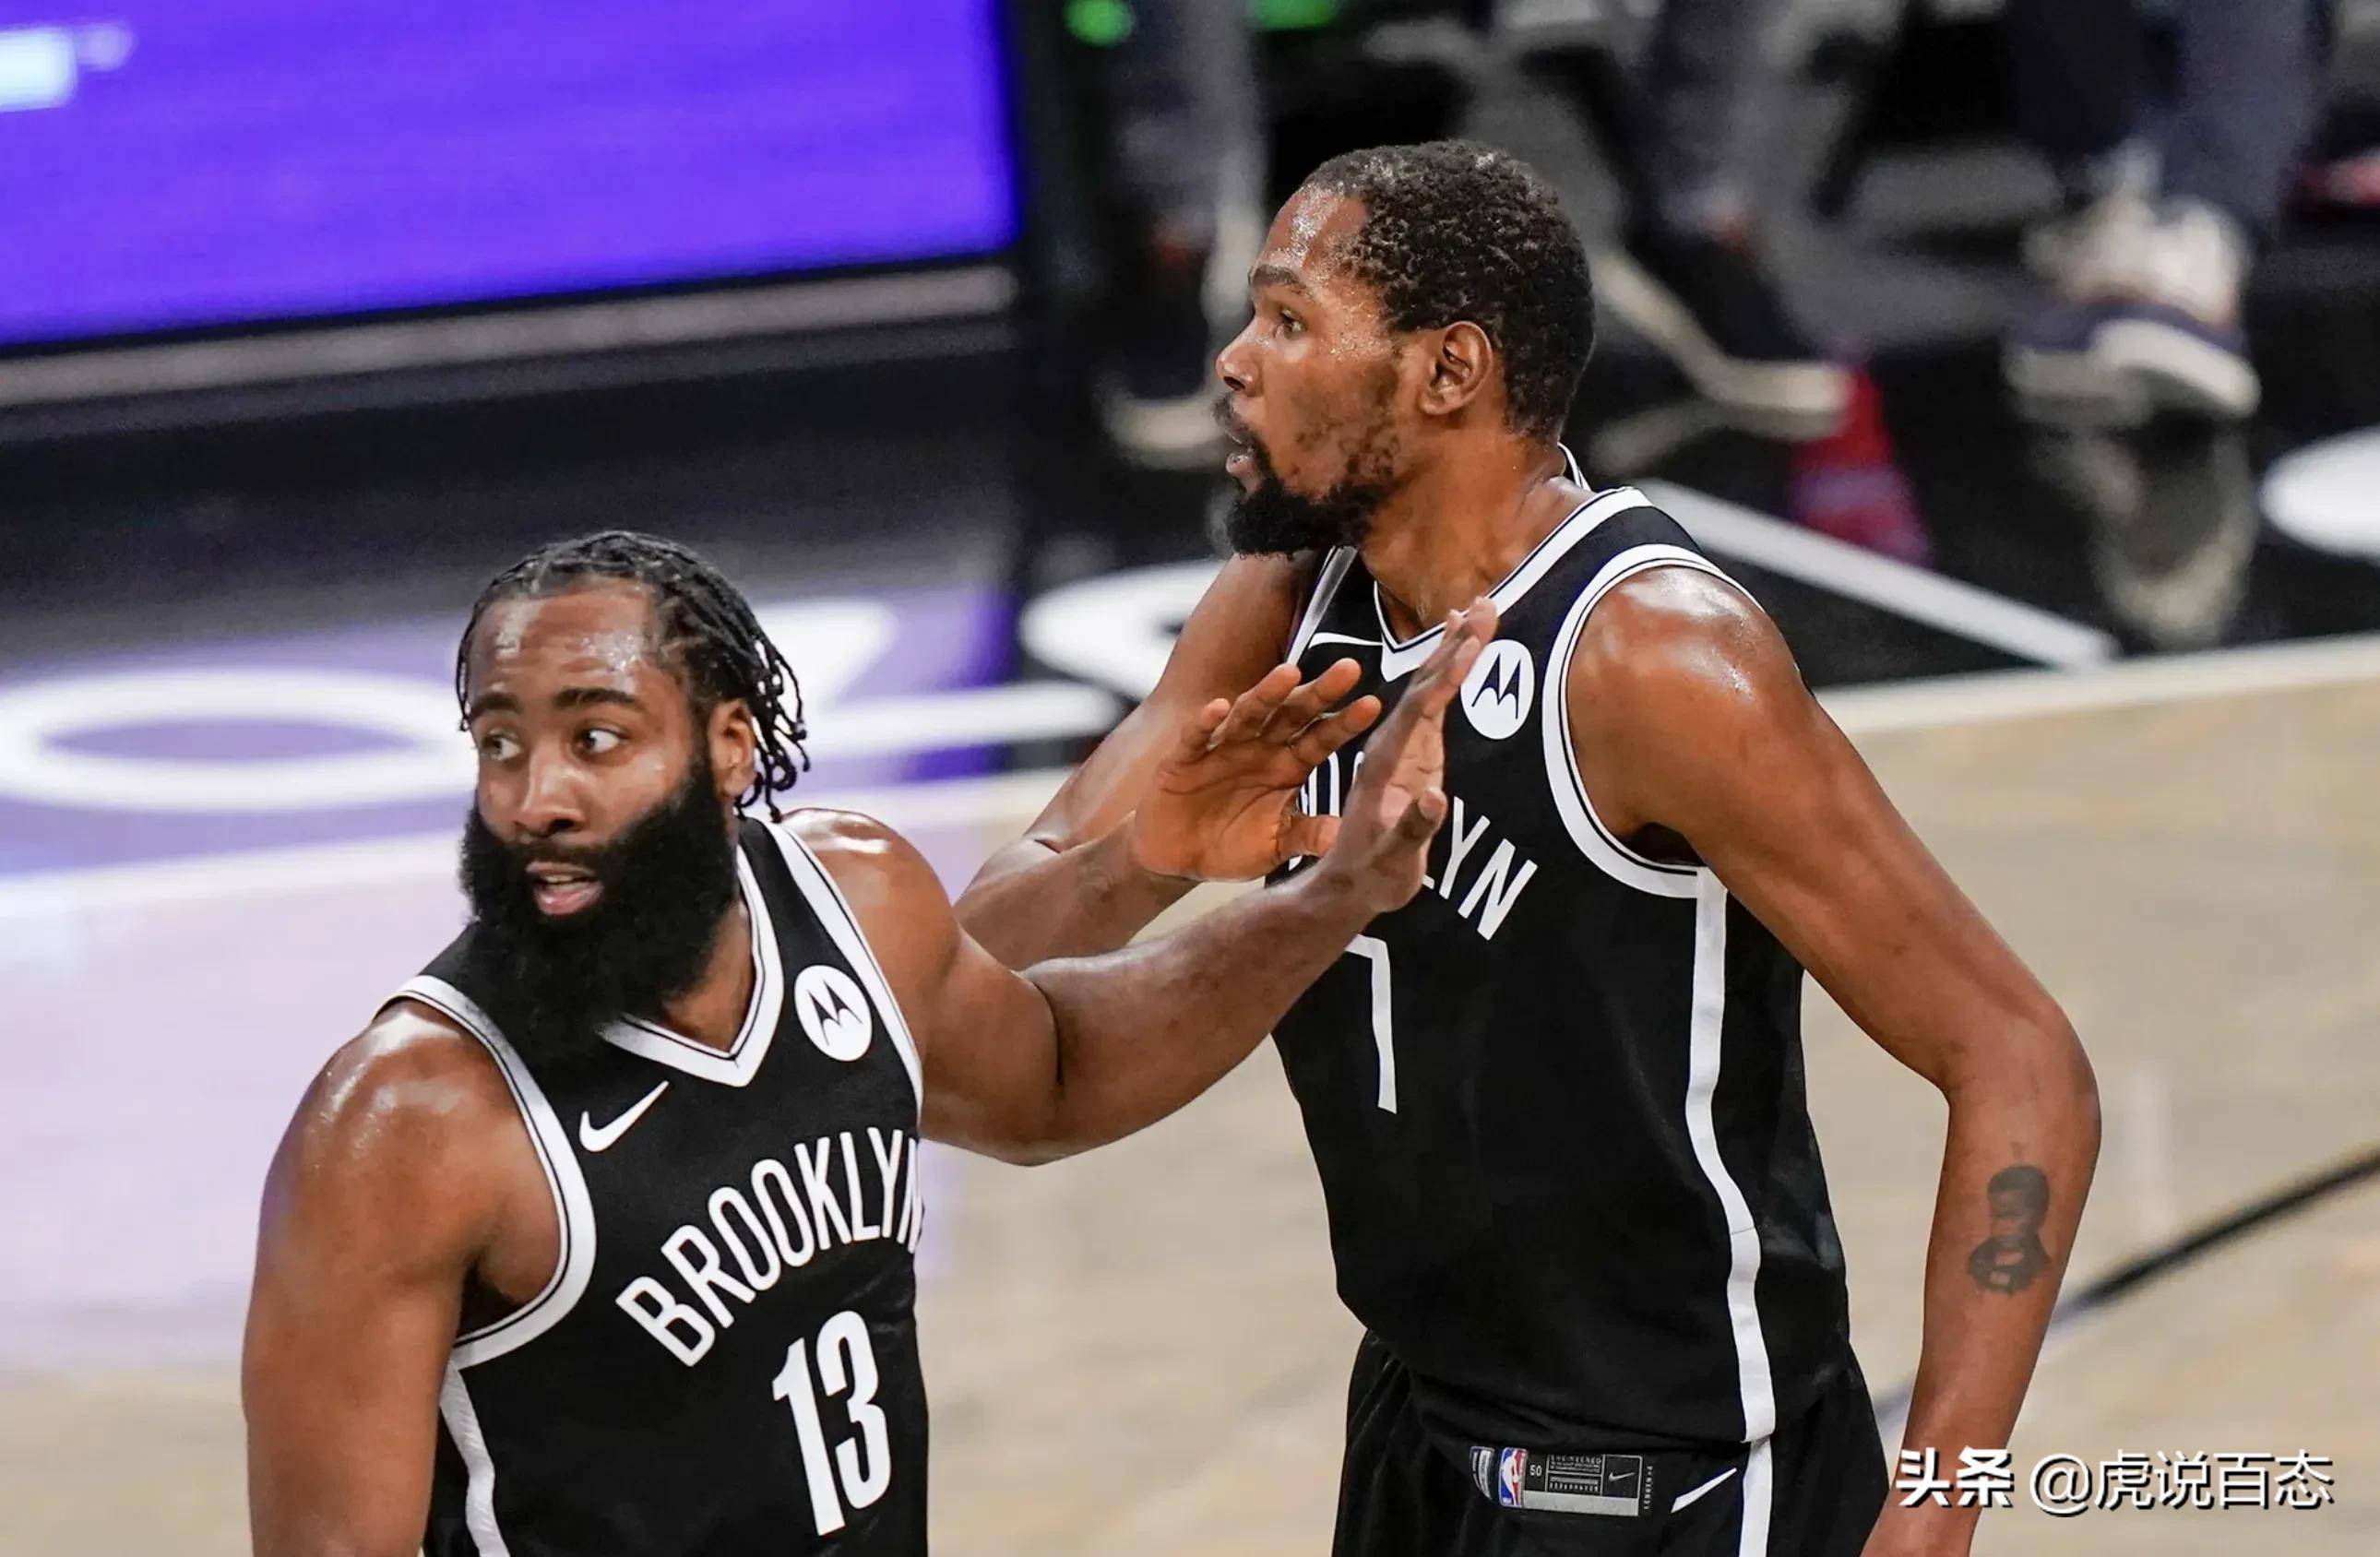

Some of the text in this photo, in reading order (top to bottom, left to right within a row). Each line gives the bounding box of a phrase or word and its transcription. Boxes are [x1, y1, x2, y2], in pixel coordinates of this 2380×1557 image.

[1344, 933, 1397, 1114] 7
[772, 1311, 891, 1536] 13
[1529, 1464, 1542, 1477] 50
